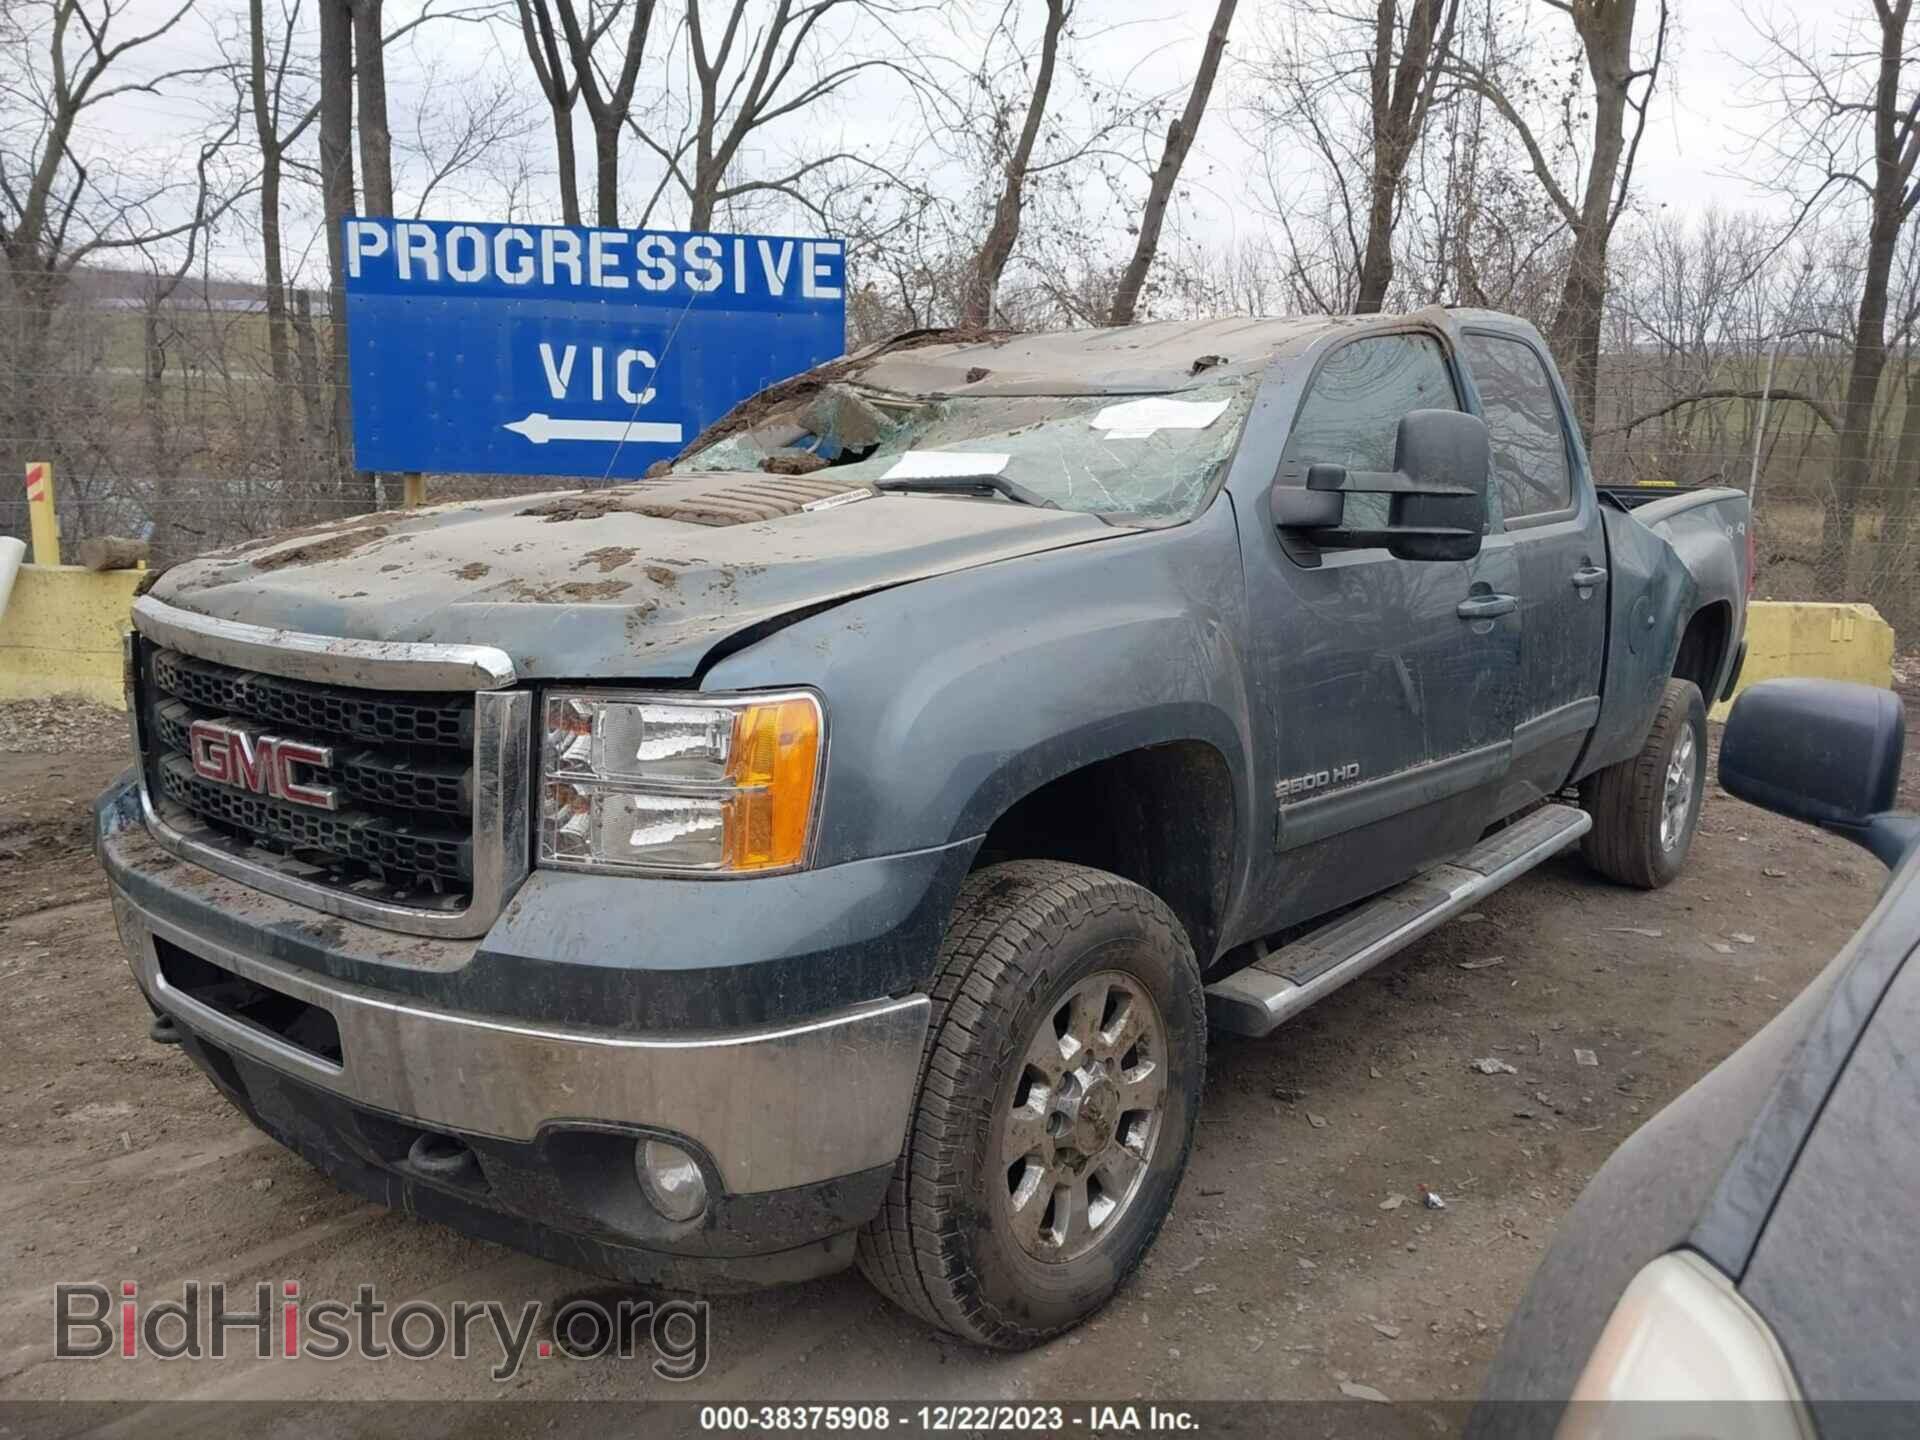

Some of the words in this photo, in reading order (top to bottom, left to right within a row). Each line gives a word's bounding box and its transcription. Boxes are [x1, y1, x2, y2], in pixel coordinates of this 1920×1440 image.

[346, 220, 843, 299] PROGRESSIVE
[539, 342, 657, 404] VIC
[190, 720, 338, 811] GMC
[1333, 763, 1360, 784] HD
